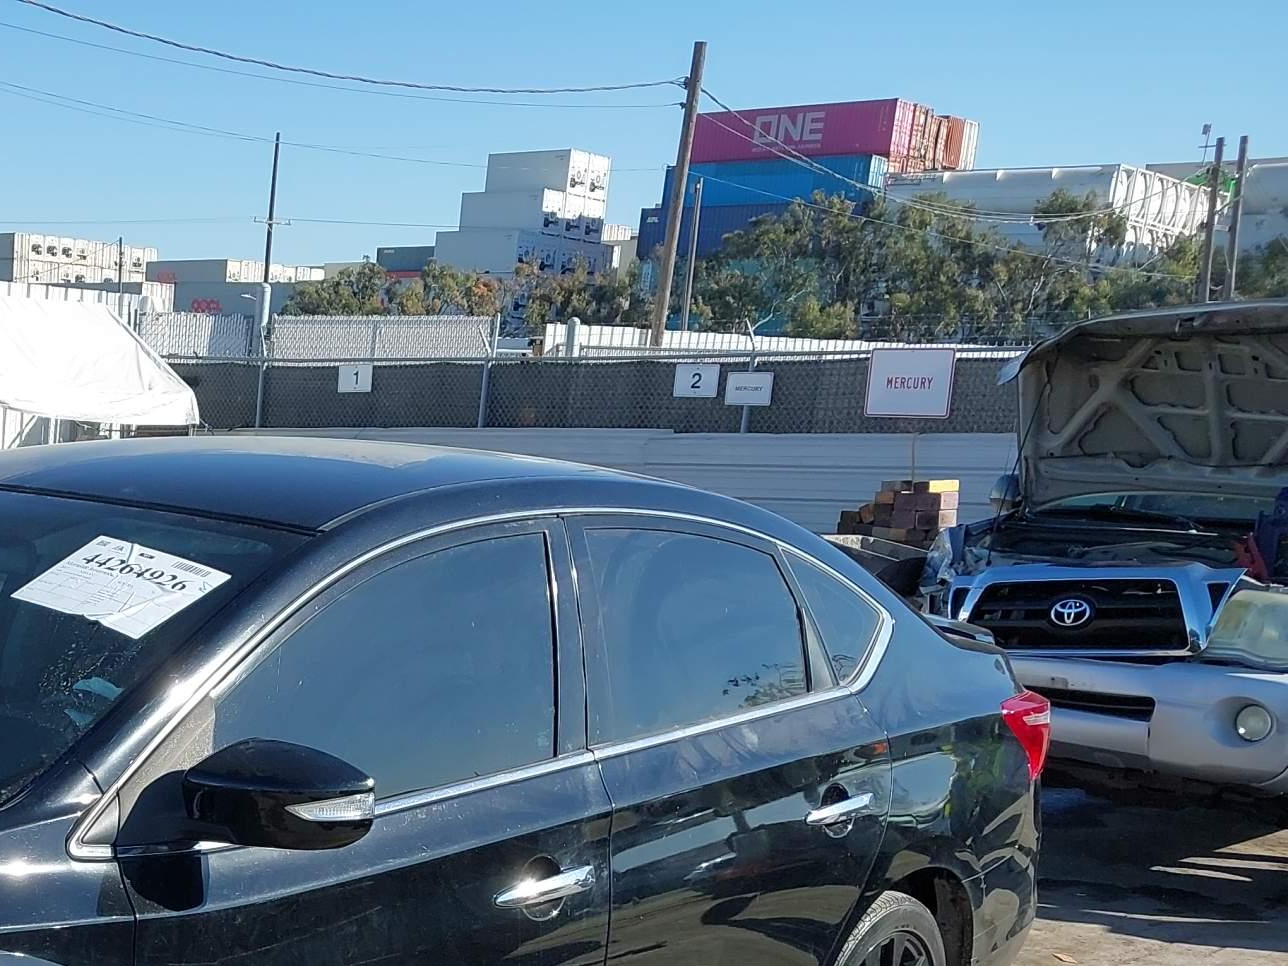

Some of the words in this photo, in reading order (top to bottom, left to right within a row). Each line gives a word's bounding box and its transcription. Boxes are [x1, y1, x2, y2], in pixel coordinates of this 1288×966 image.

[753, 111, 825, 143] ONE
[353, 370, 359, 385] 1
[690, 372, 702, 389] 2
[886, 376, 933, 390] MERCURY
[82, 554, 191, 591] 44264926
